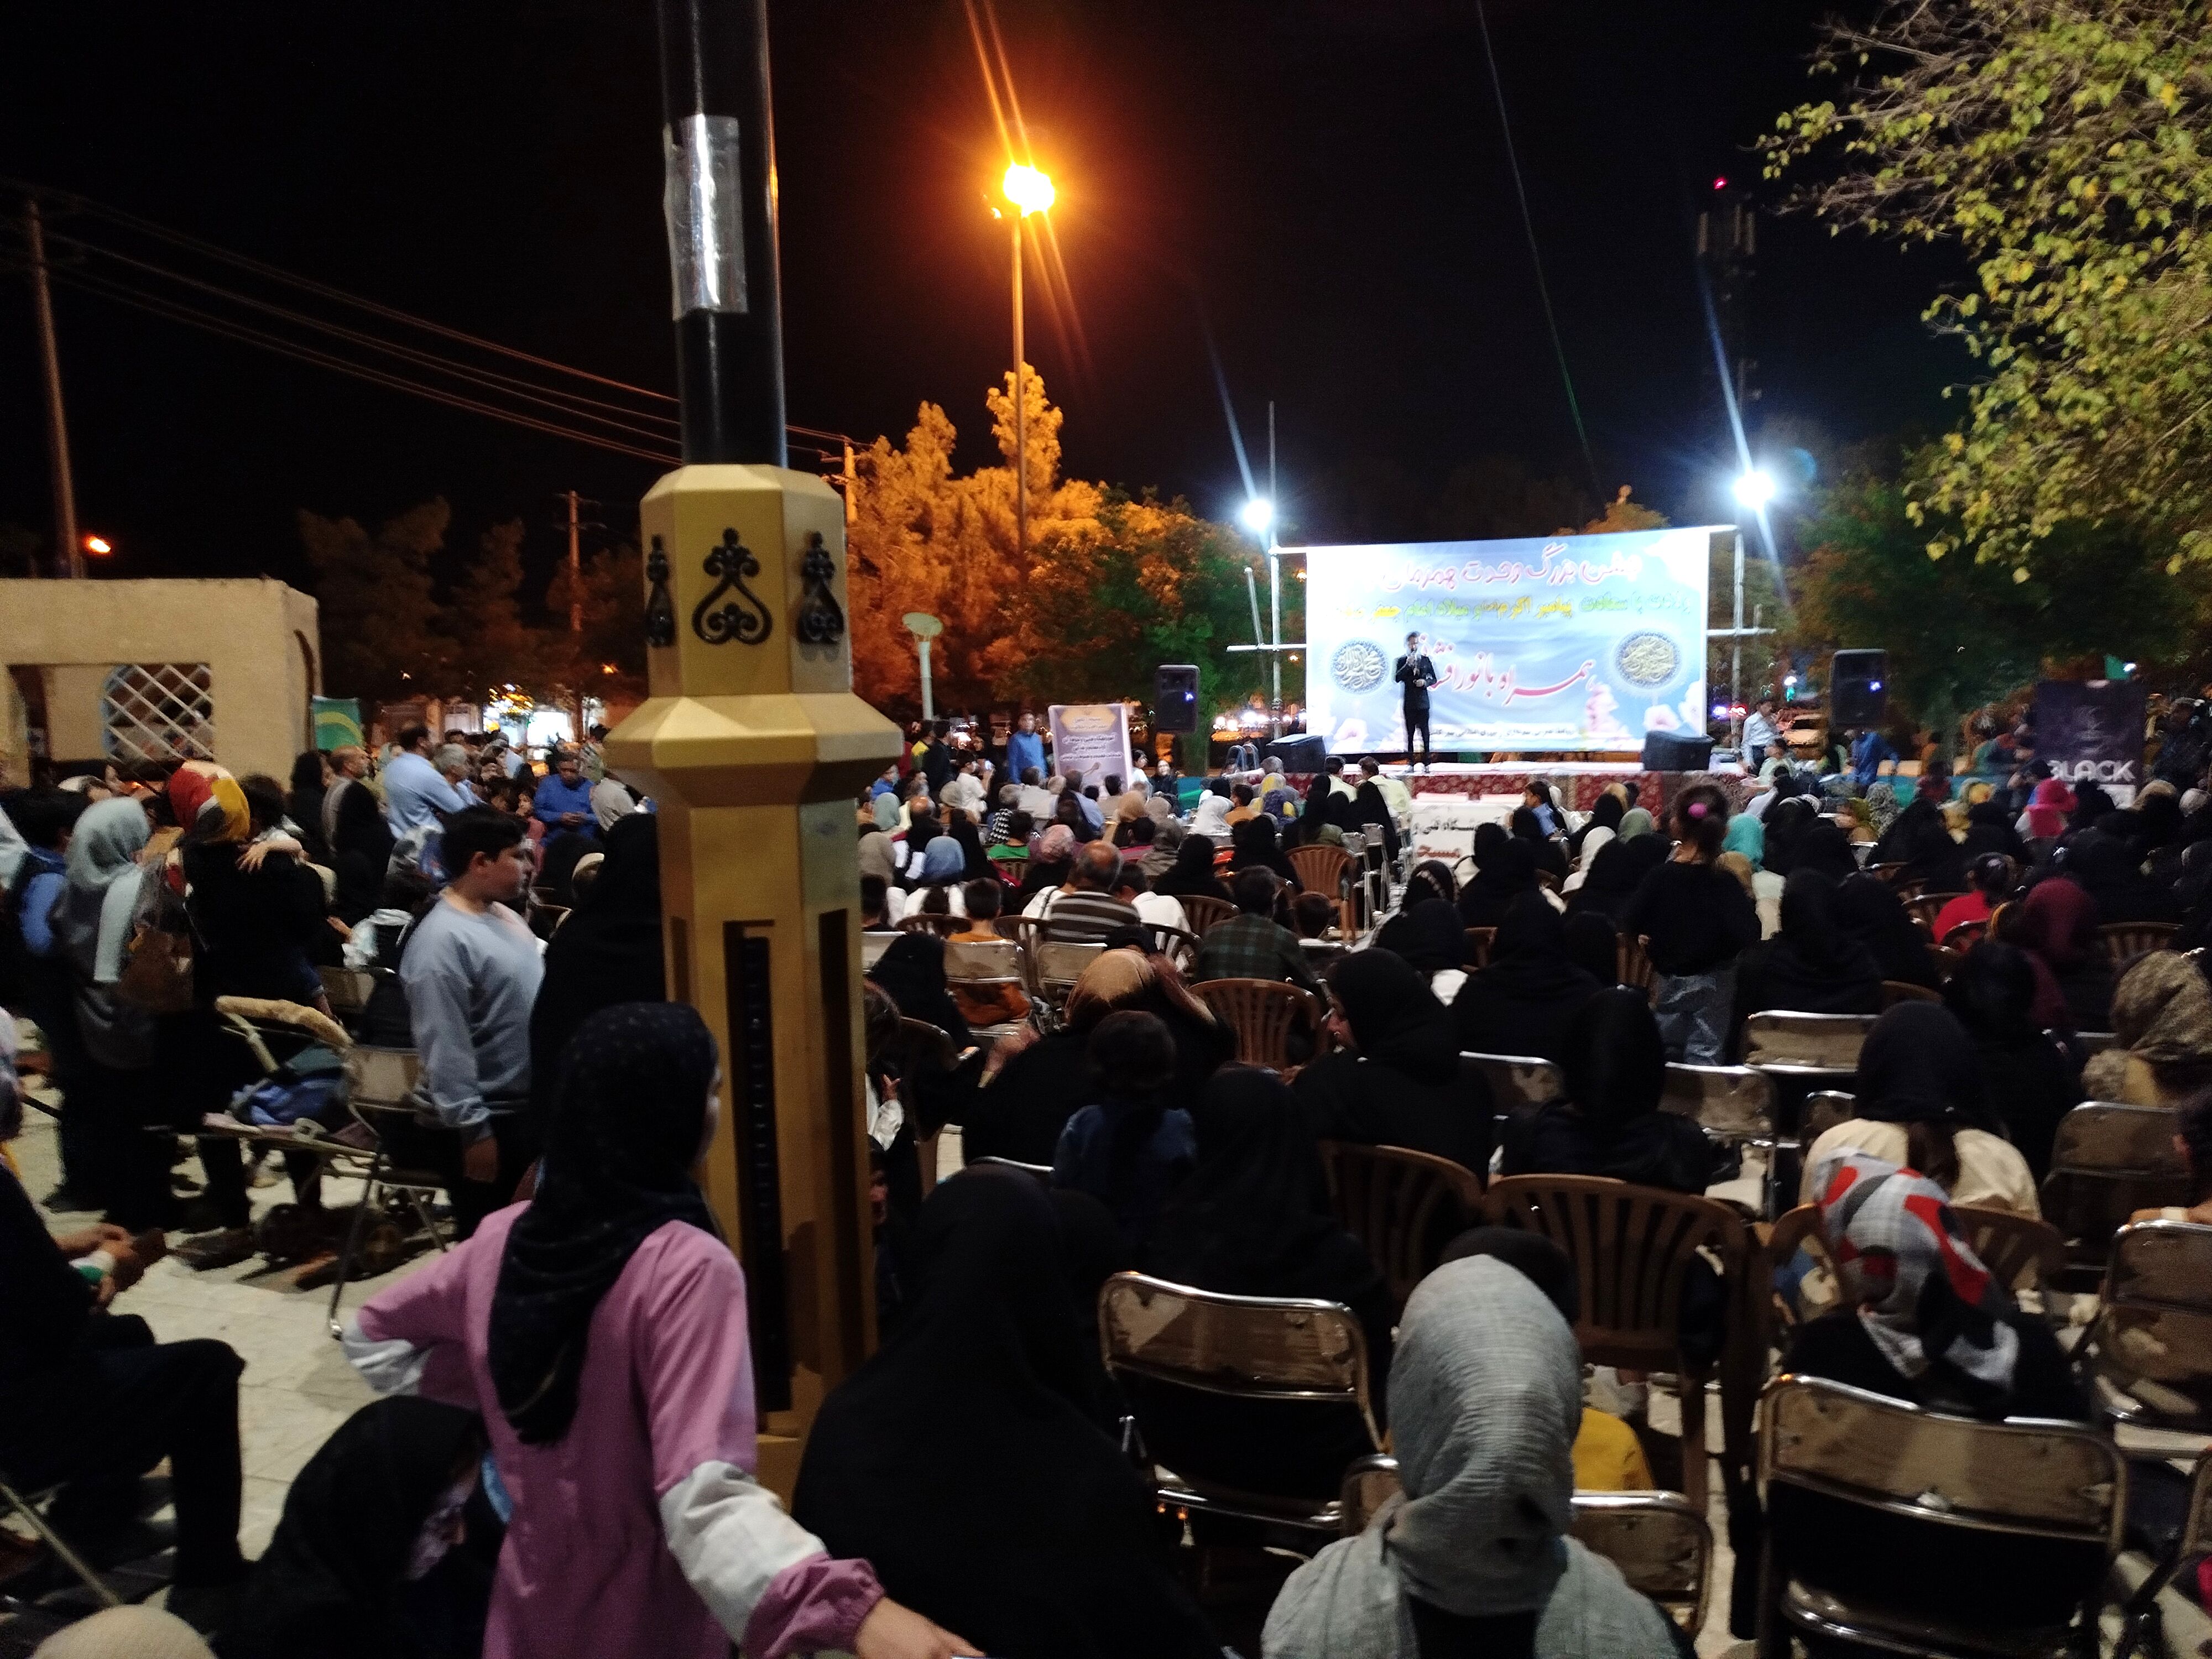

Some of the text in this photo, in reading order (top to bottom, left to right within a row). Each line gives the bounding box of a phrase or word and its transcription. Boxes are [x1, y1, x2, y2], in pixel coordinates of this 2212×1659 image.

[1462, 561, 1521, 584] وحدت
[1526, 543, 1575, 585] بزرگ
[1533, 594, 1572, 620] پیامبر
